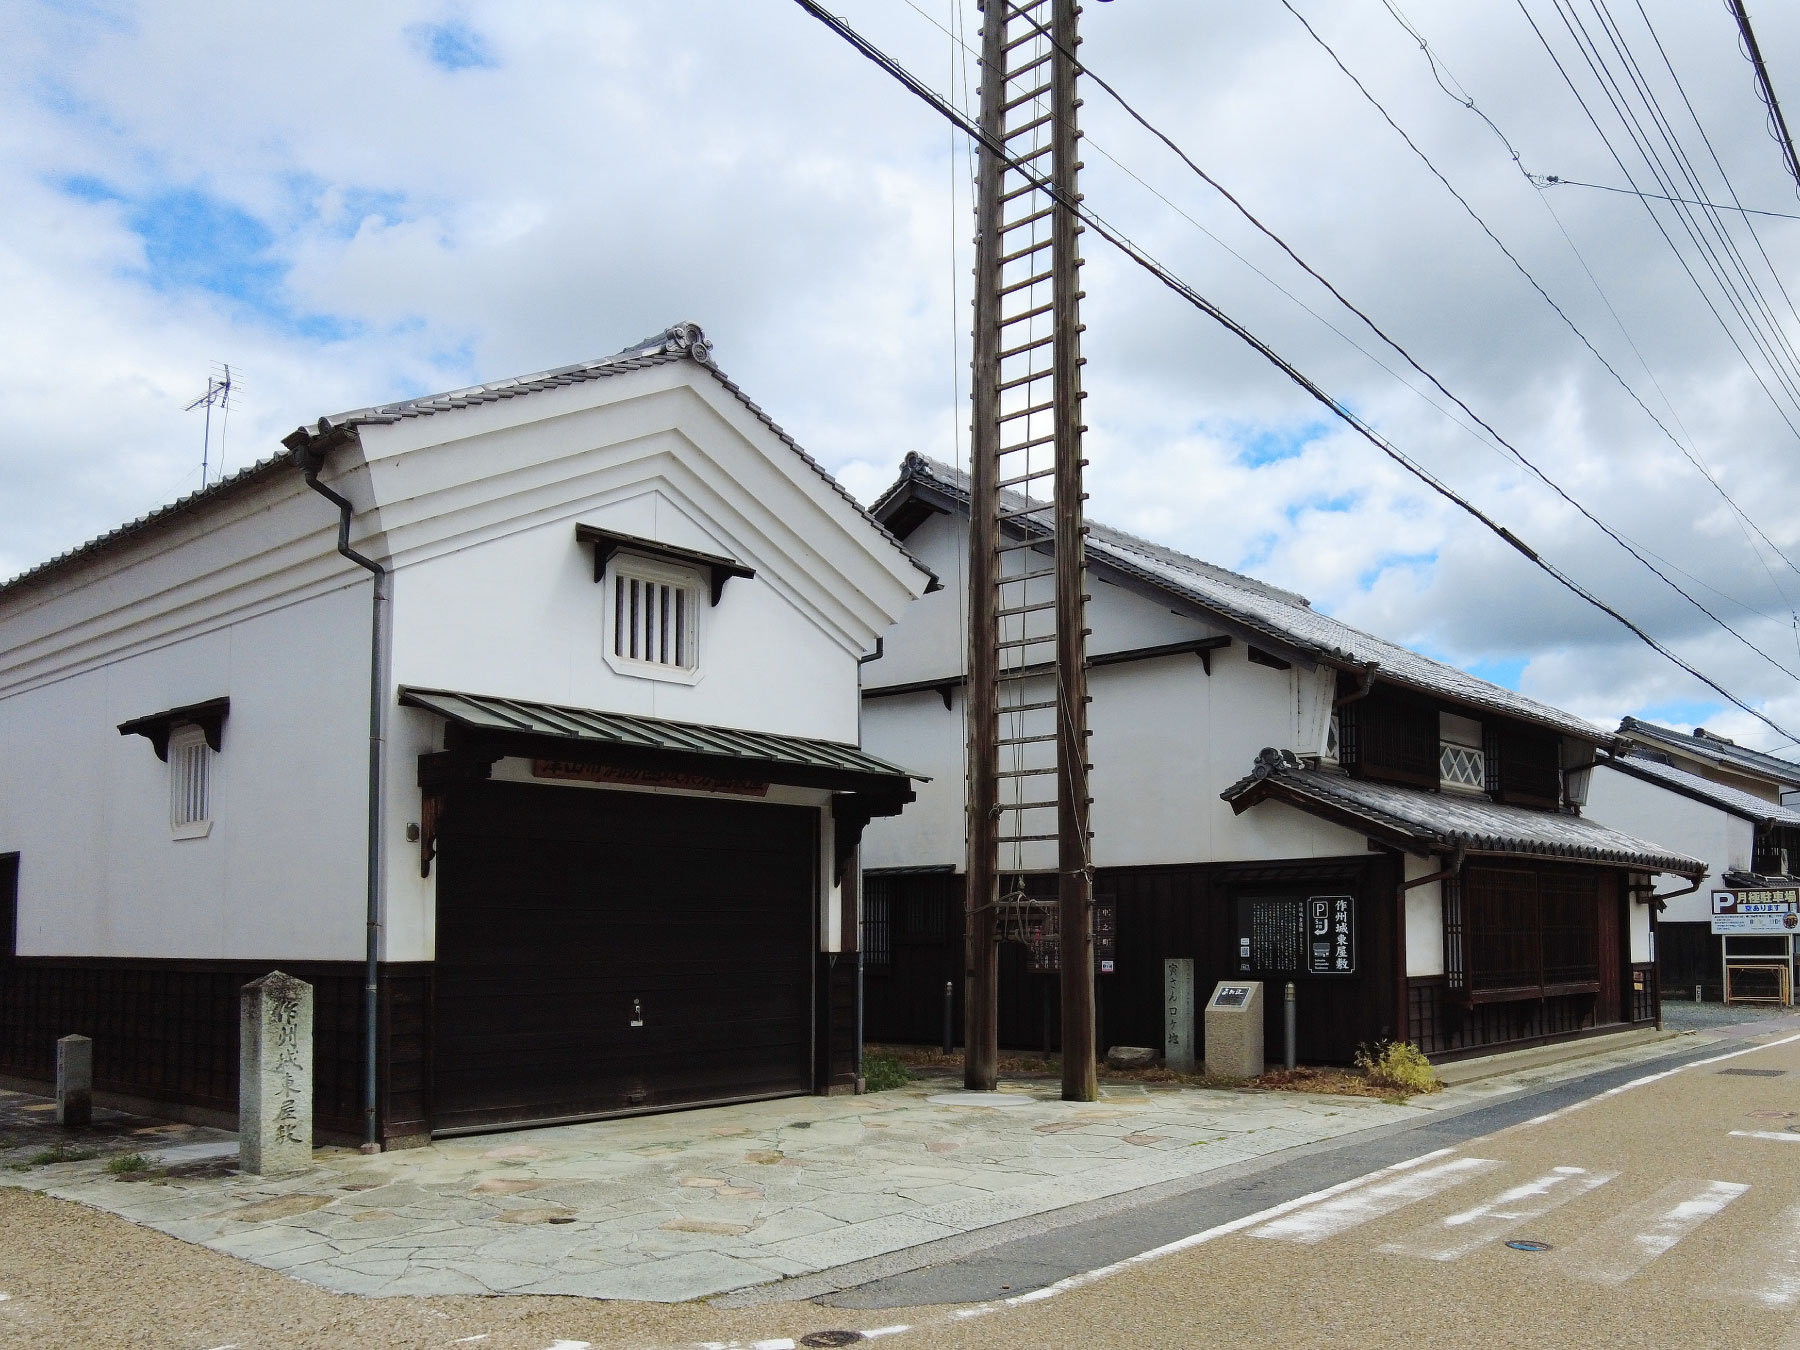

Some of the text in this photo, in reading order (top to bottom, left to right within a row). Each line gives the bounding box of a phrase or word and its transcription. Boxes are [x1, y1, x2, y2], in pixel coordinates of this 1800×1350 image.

[1714, 893, 1734, 913] P
[1737, 891, 1796, 903] 月極駐車場
[1316, 903, 1324, 916] P
[1335, 900, 1349, 969] 作州城東屋敷
[272, 1001, 303, 1144] 作州城東屋敷
